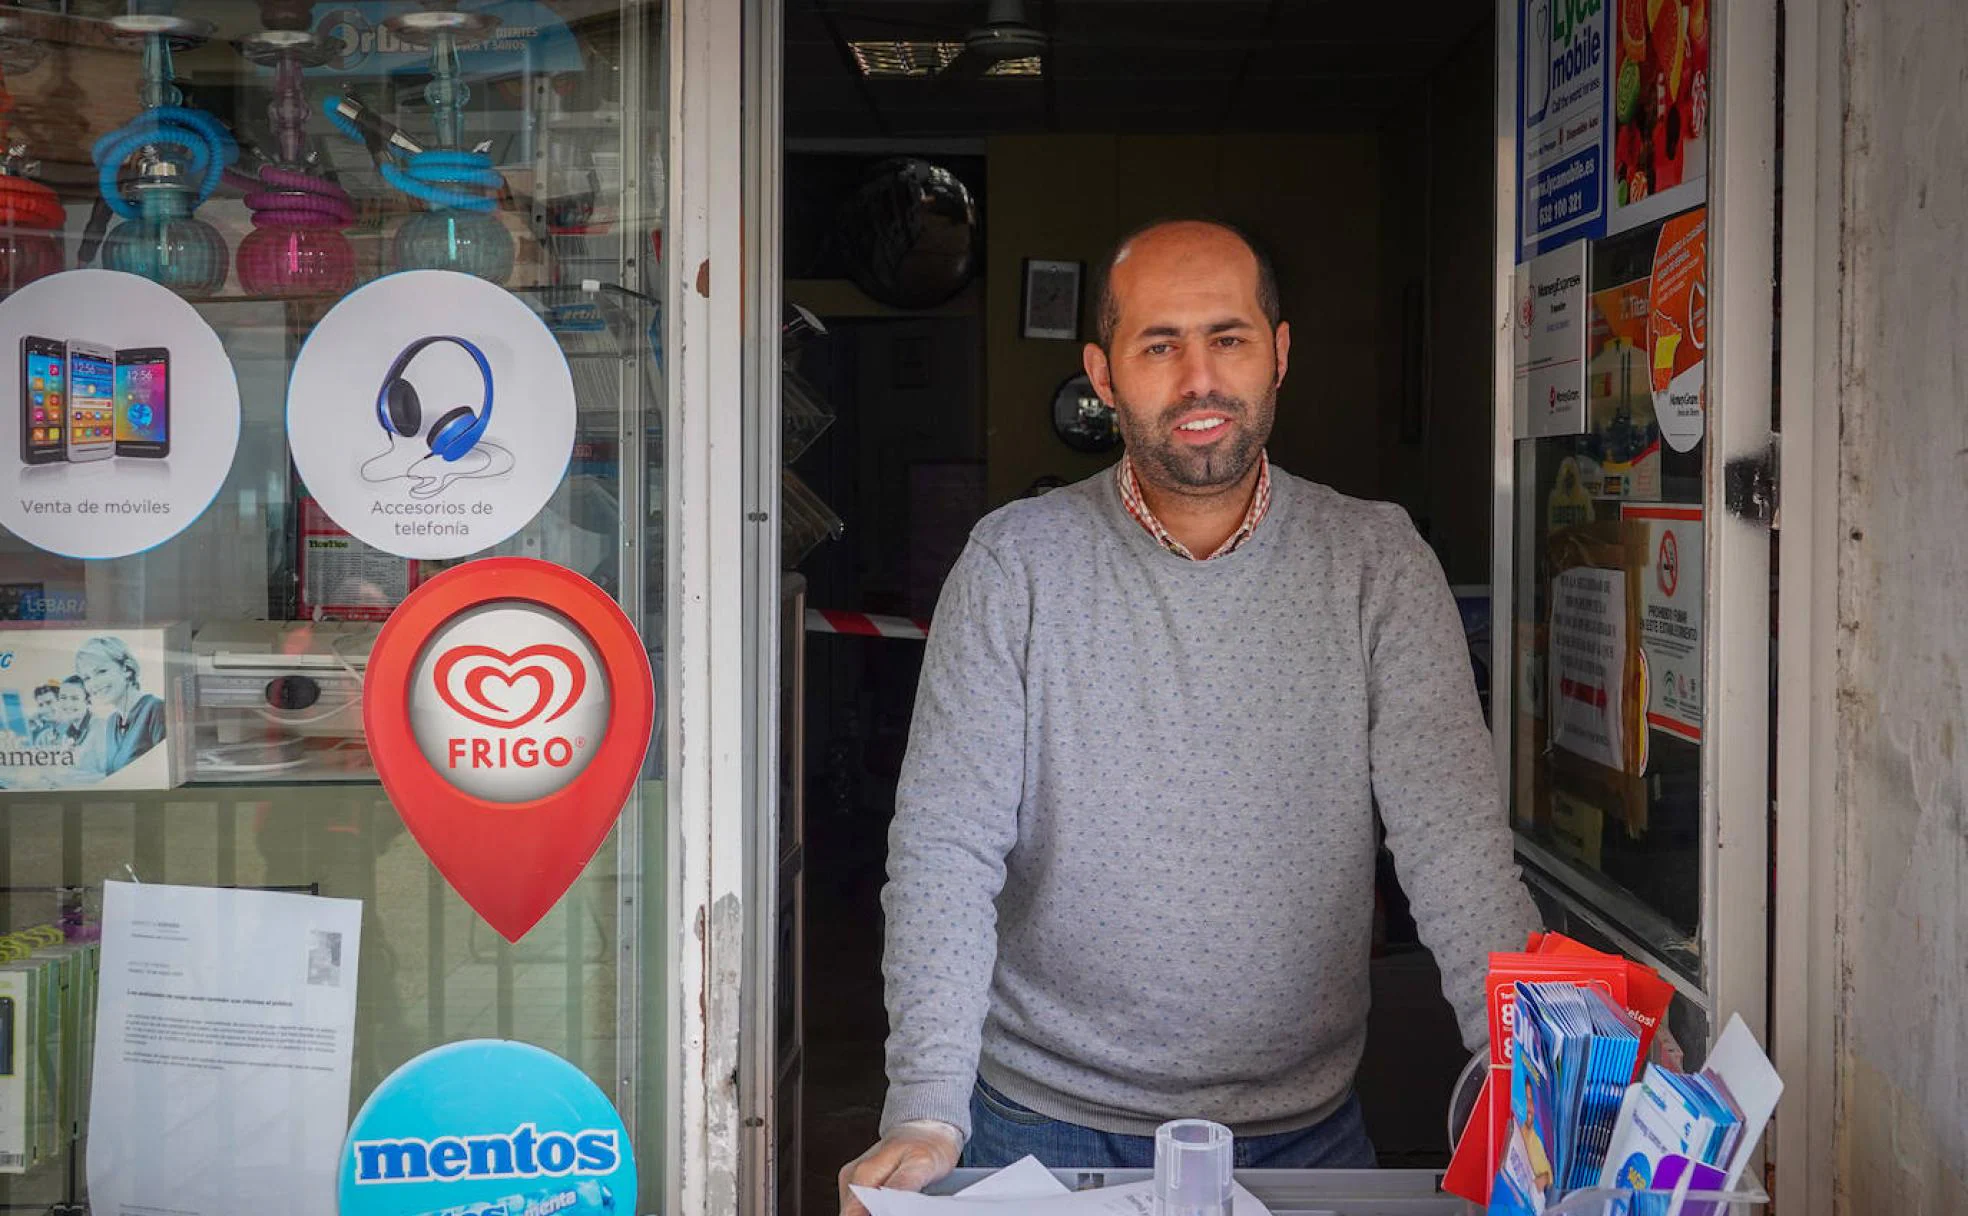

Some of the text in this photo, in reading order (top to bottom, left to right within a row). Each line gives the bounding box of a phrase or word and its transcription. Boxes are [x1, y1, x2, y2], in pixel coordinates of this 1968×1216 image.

[1551, 25, 1601, 90] mobile
[21, 499, 170, 514] Venta de móviles
[371, 500, 493, 515] Accesorios de
[395, 520, 469, 536] telefonía
[448, 736, 573, 769] FRIGO
[355, 1124, 619, 1184] mentos
